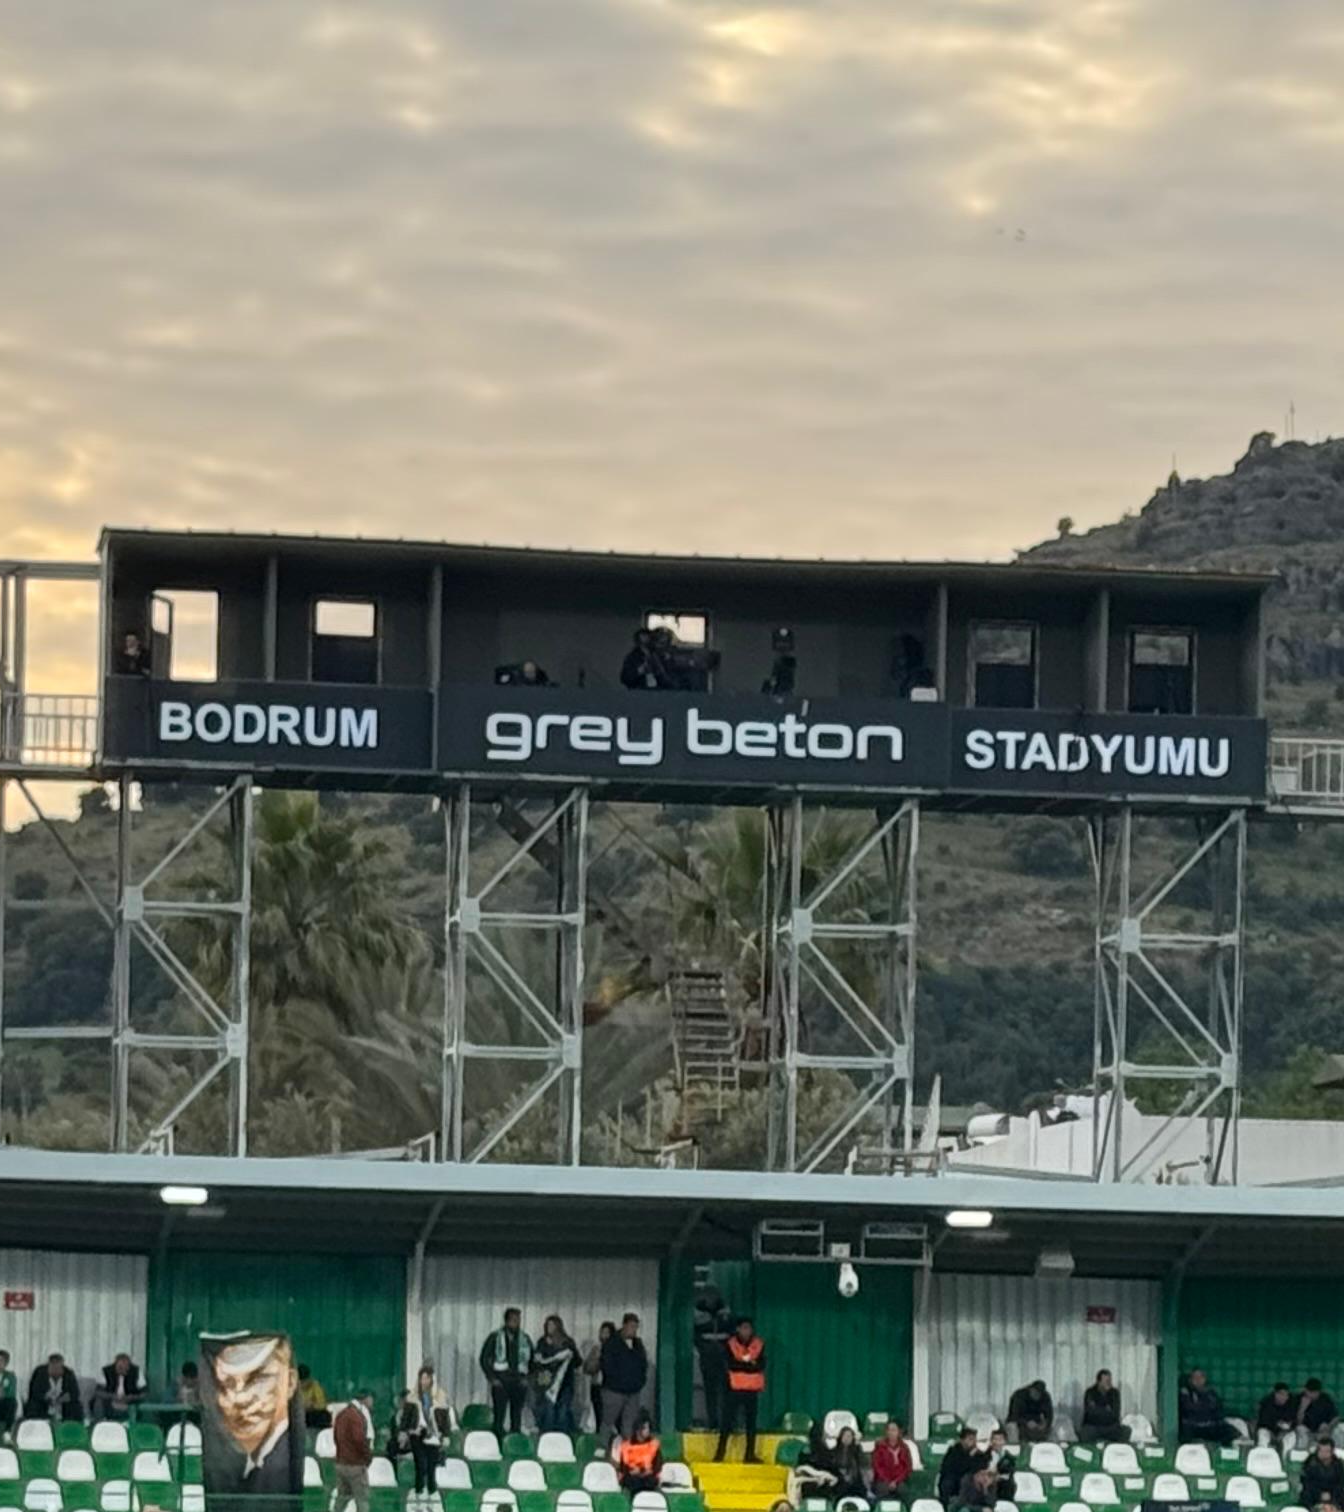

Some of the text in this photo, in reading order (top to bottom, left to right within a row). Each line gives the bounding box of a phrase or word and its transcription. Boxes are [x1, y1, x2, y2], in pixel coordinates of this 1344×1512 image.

[159, 700, 378, 749] BODRUM
[485, 709, 904, 767] grey beton
[964, 729, 1230, 778] STADYUMU
